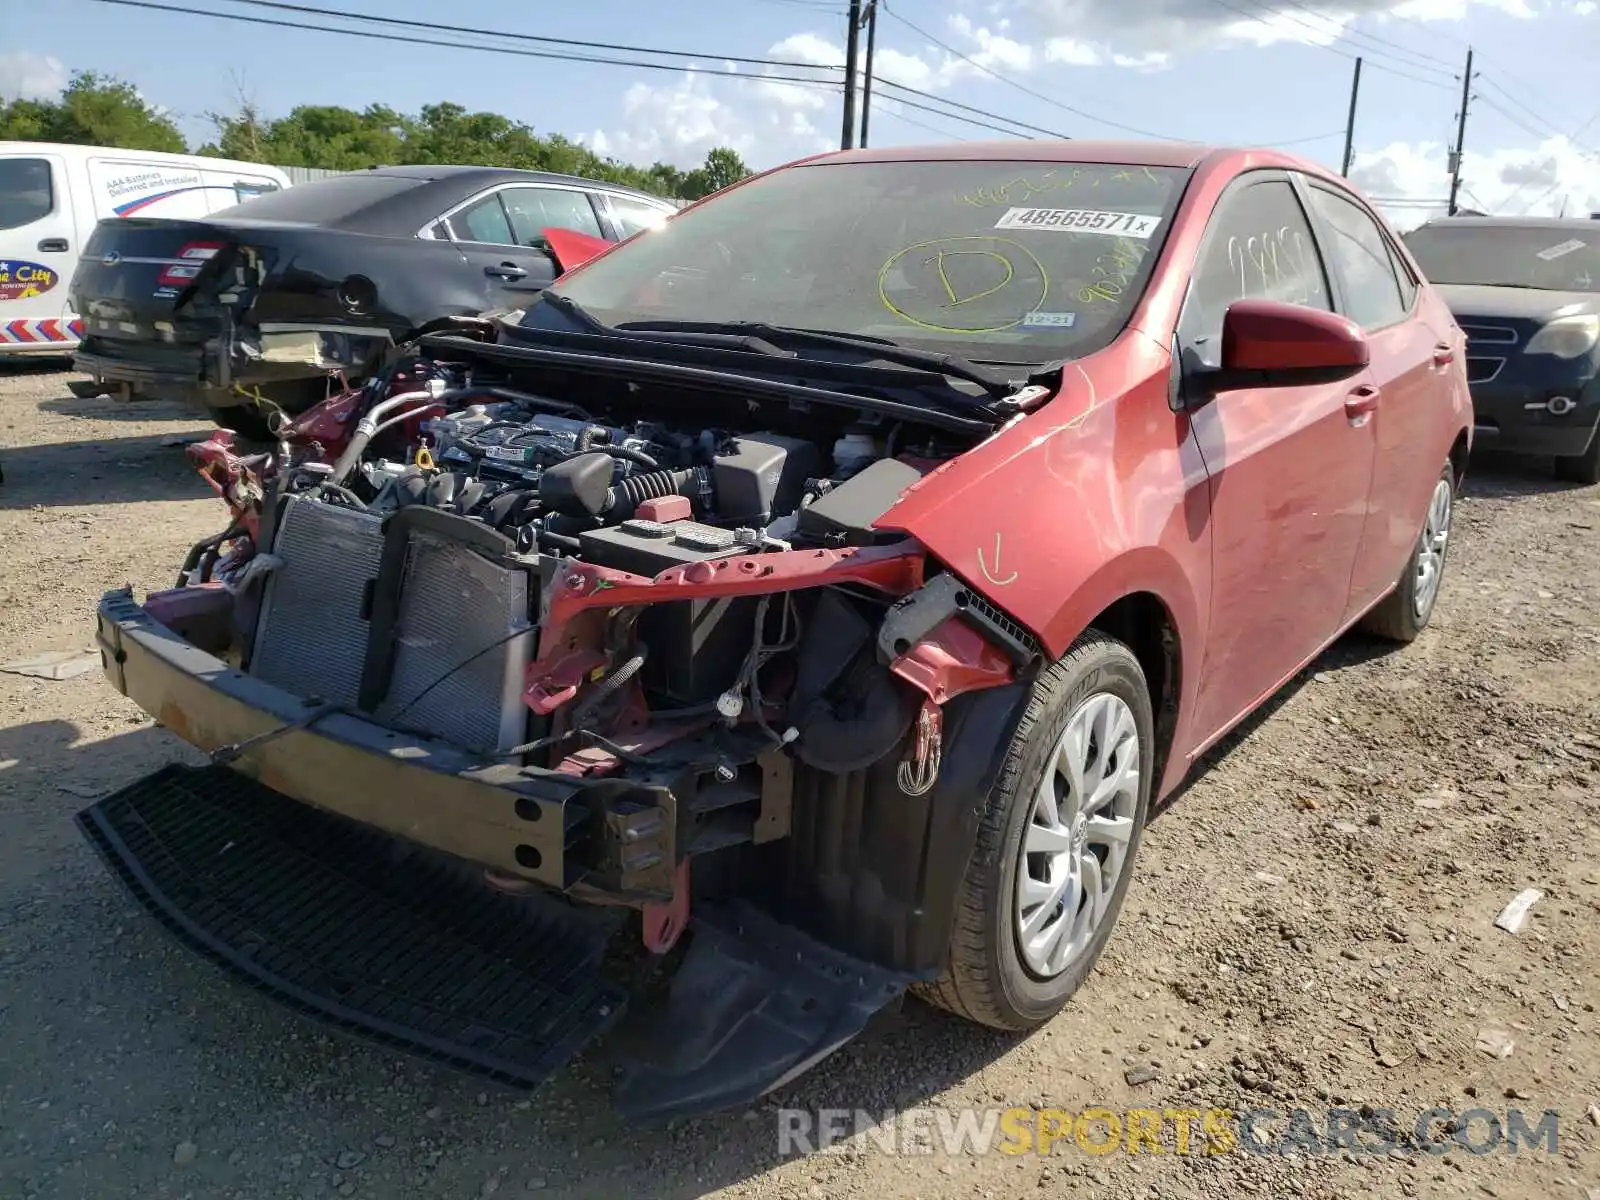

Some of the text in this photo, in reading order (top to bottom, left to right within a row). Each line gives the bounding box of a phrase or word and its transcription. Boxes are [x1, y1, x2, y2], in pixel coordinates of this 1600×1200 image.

[106, 172, 161, 189] AAA Batteries
[108, 174, 198, 198] Delivered and Installed
[16, 265, 51, 285] City
